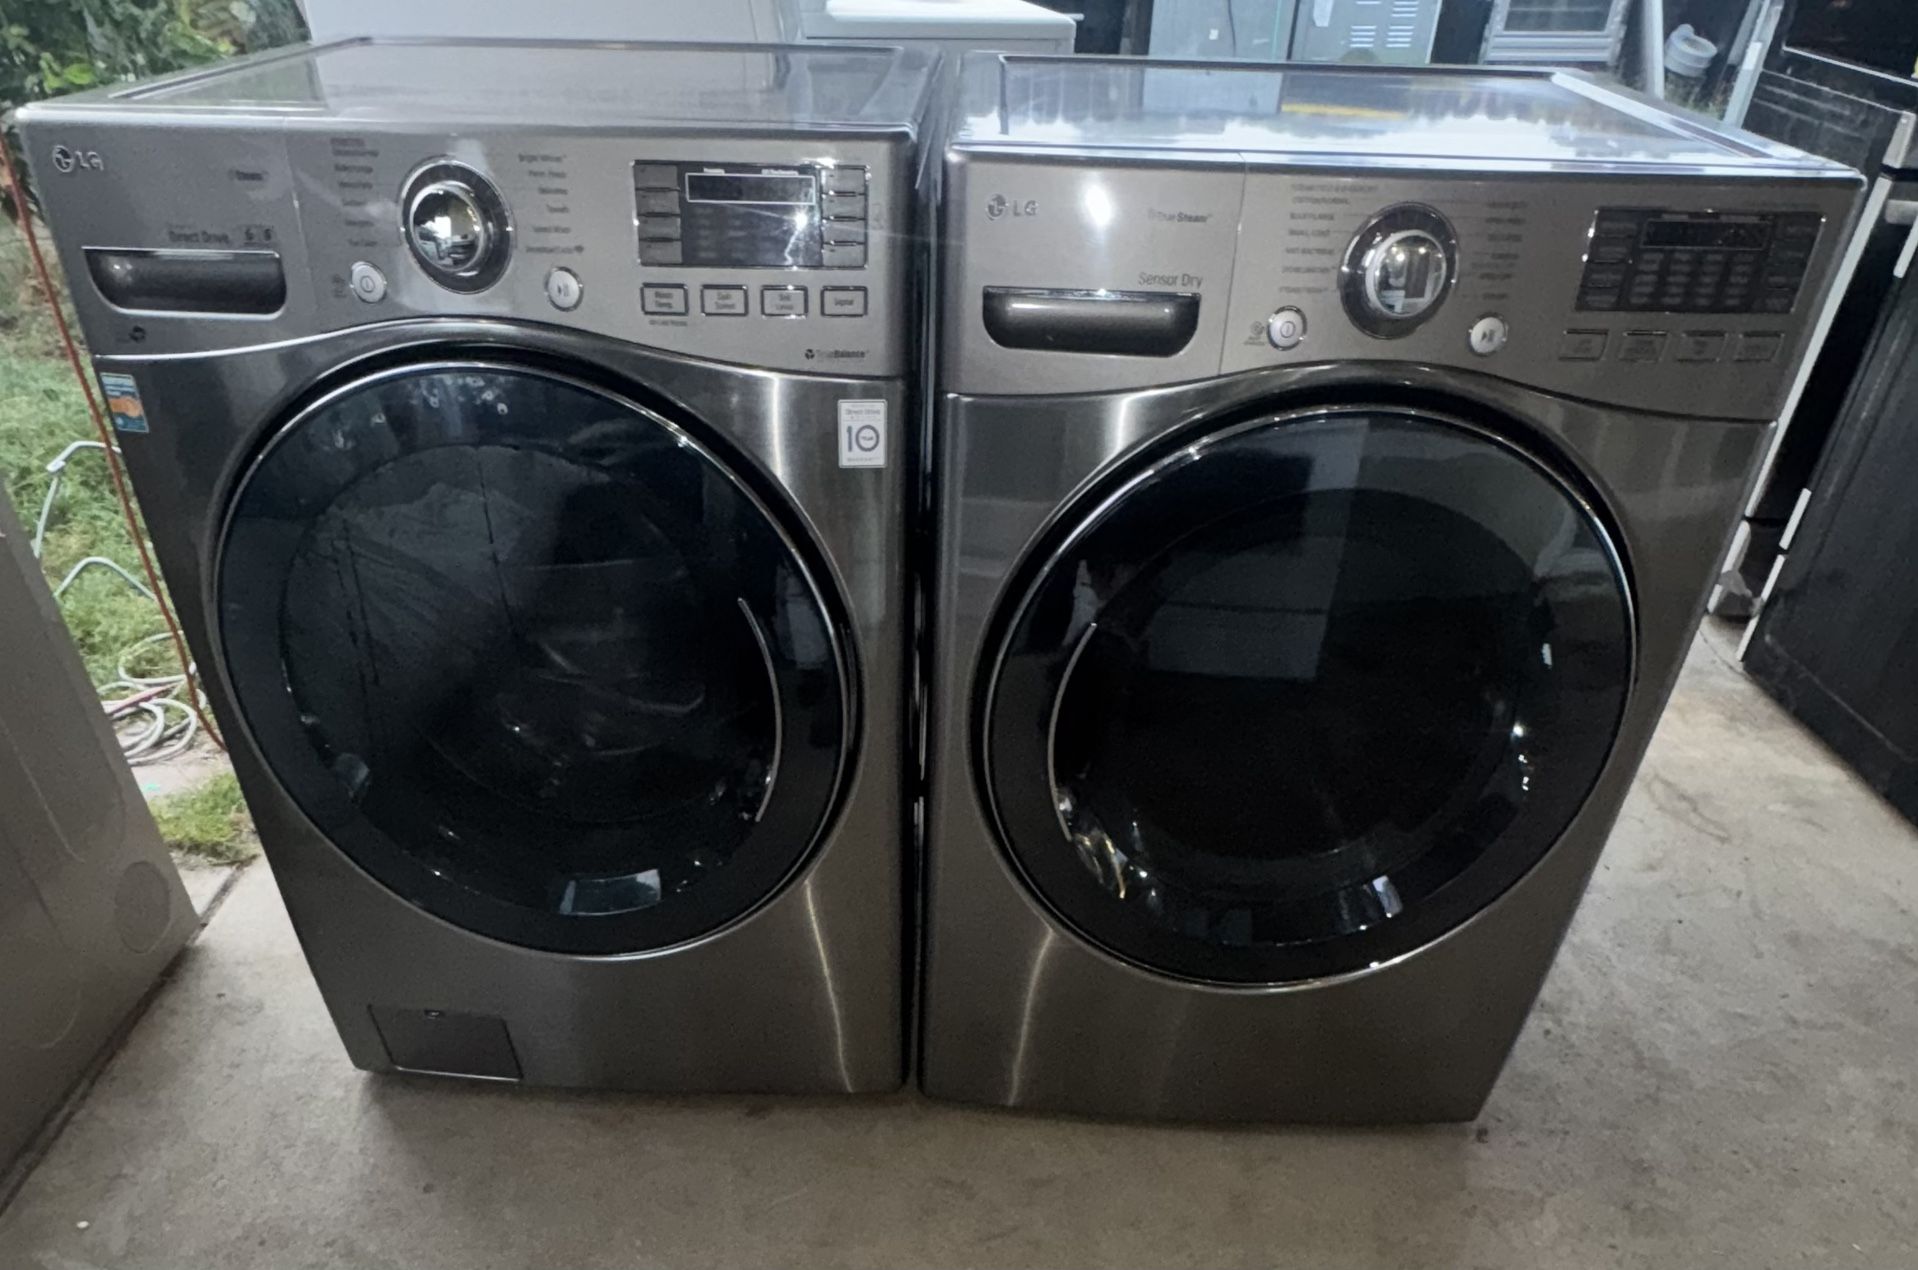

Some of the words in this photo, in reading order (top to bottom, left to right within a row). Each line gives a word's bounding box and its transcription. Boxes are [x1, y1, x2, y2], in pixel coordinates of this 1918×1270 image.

[74, 149, 104, 171] LG
[1012, 198, 1039, 217] LG
[1138, 271, 1179, 287] Sensor
[1181, 273, 1203, 289] Dry
[846, 424, 880, 453] 10
